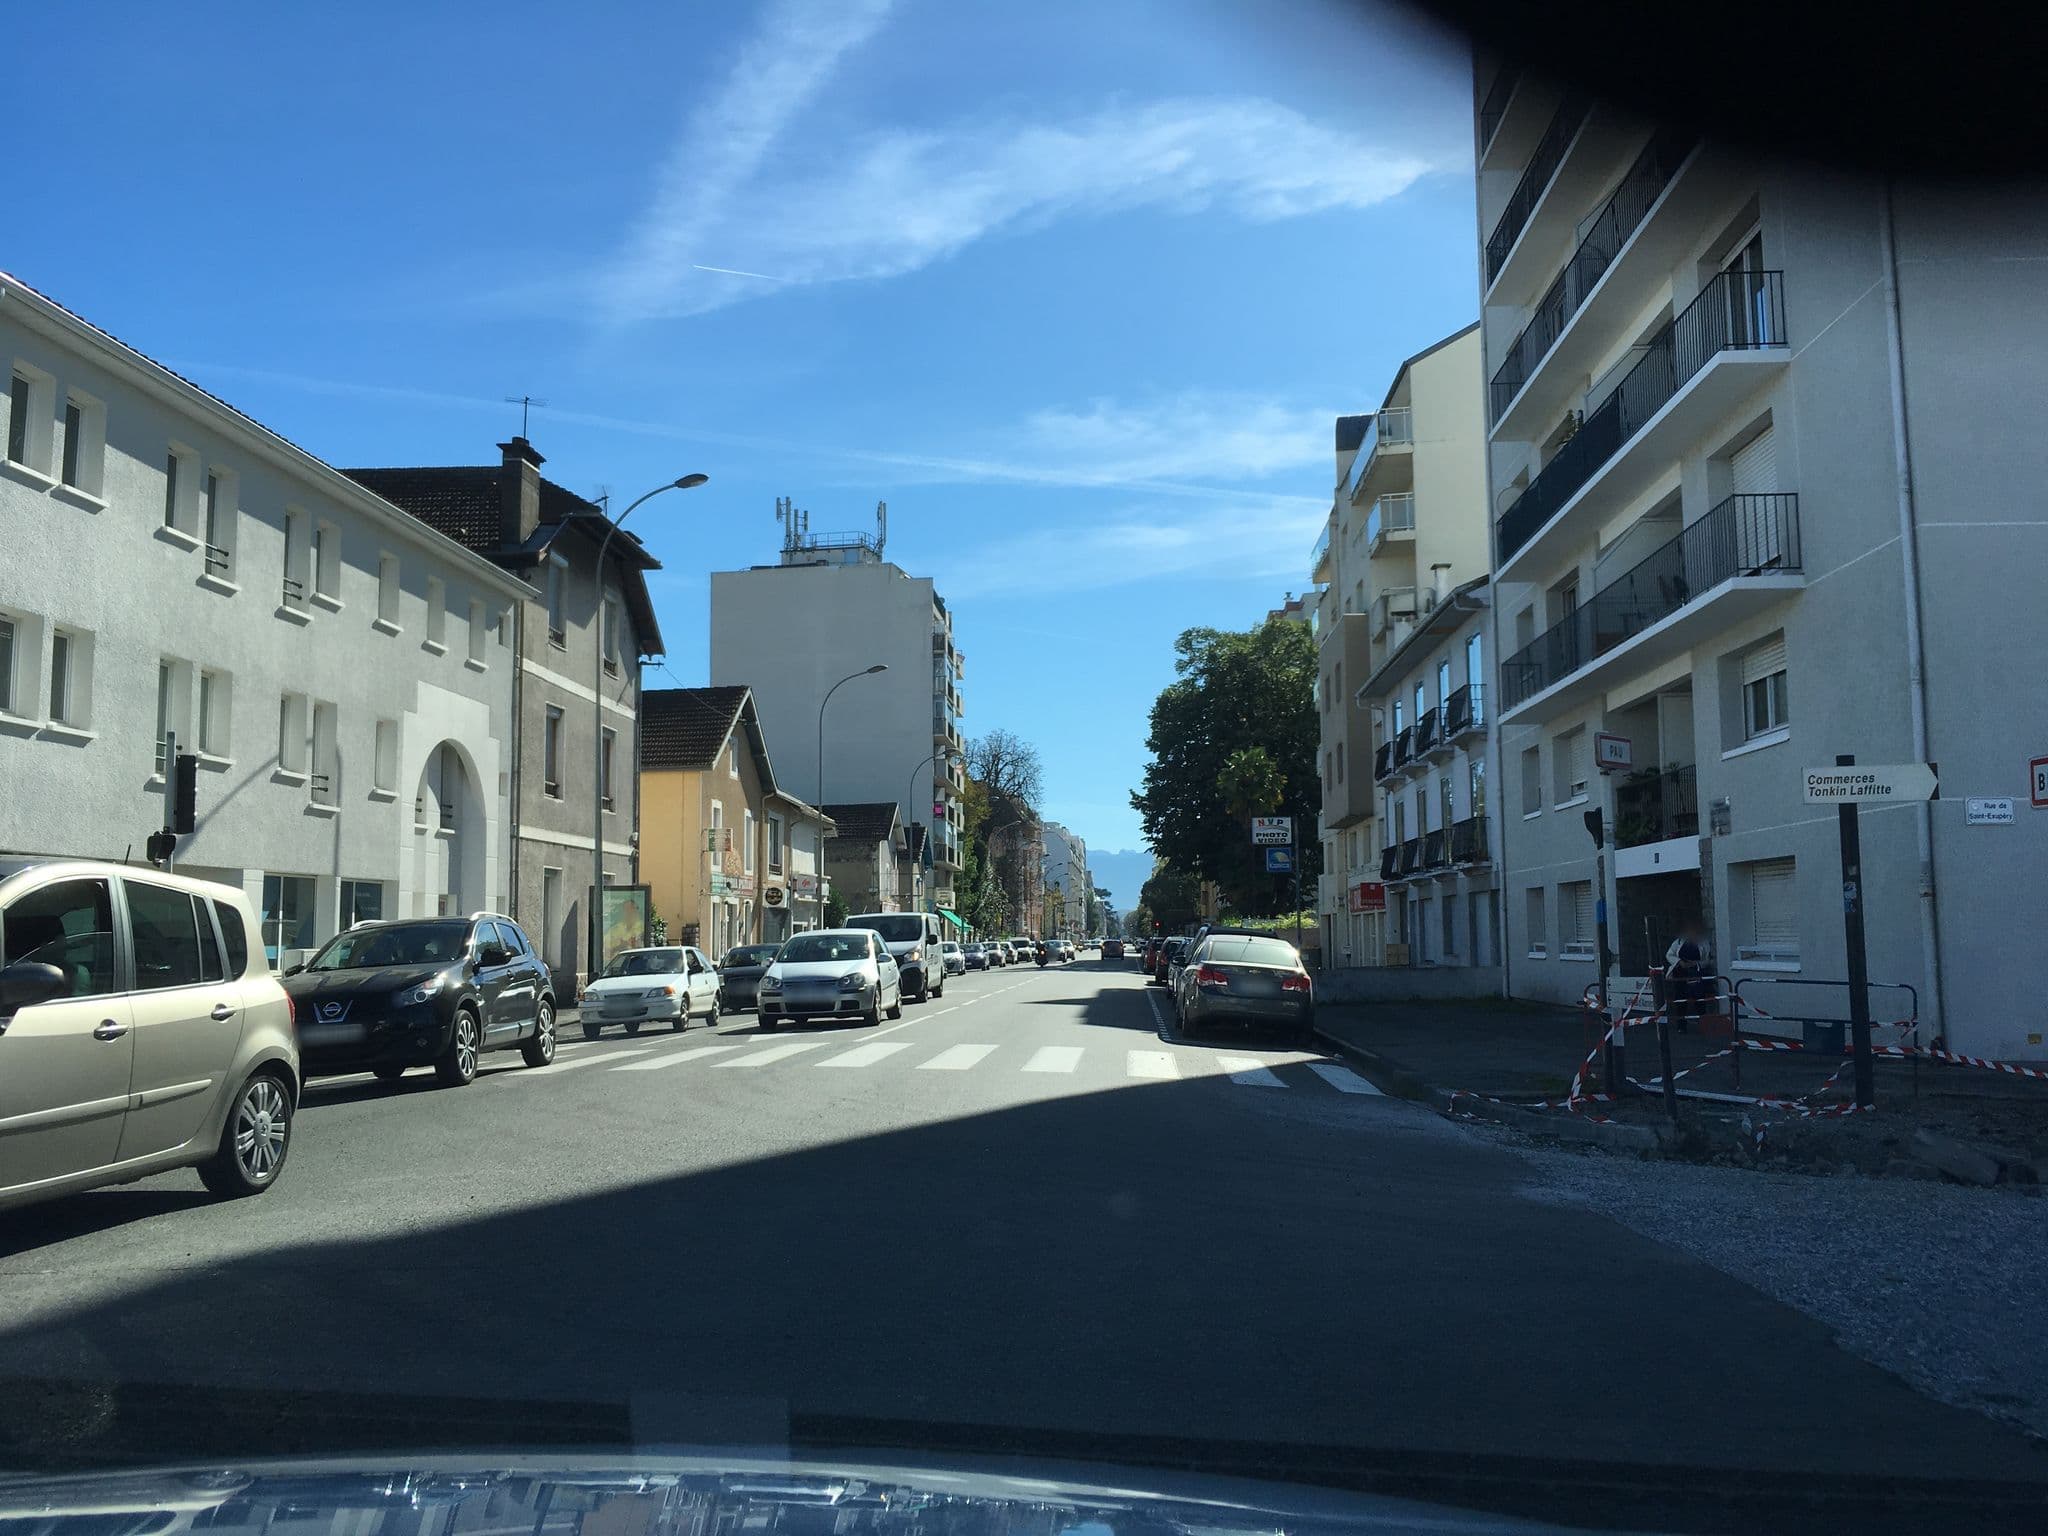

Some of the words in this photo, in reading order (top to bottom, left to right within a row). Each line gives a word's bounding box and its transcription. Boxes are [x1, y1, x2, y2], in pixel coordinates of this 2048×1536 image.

[1807, 774, 1875, 786] Commerces
[2038, 772, 2048, 792] B
[1808, 785, 1846, 797] Tonkin
[1850, 784, 1892, 796] Laffitte
